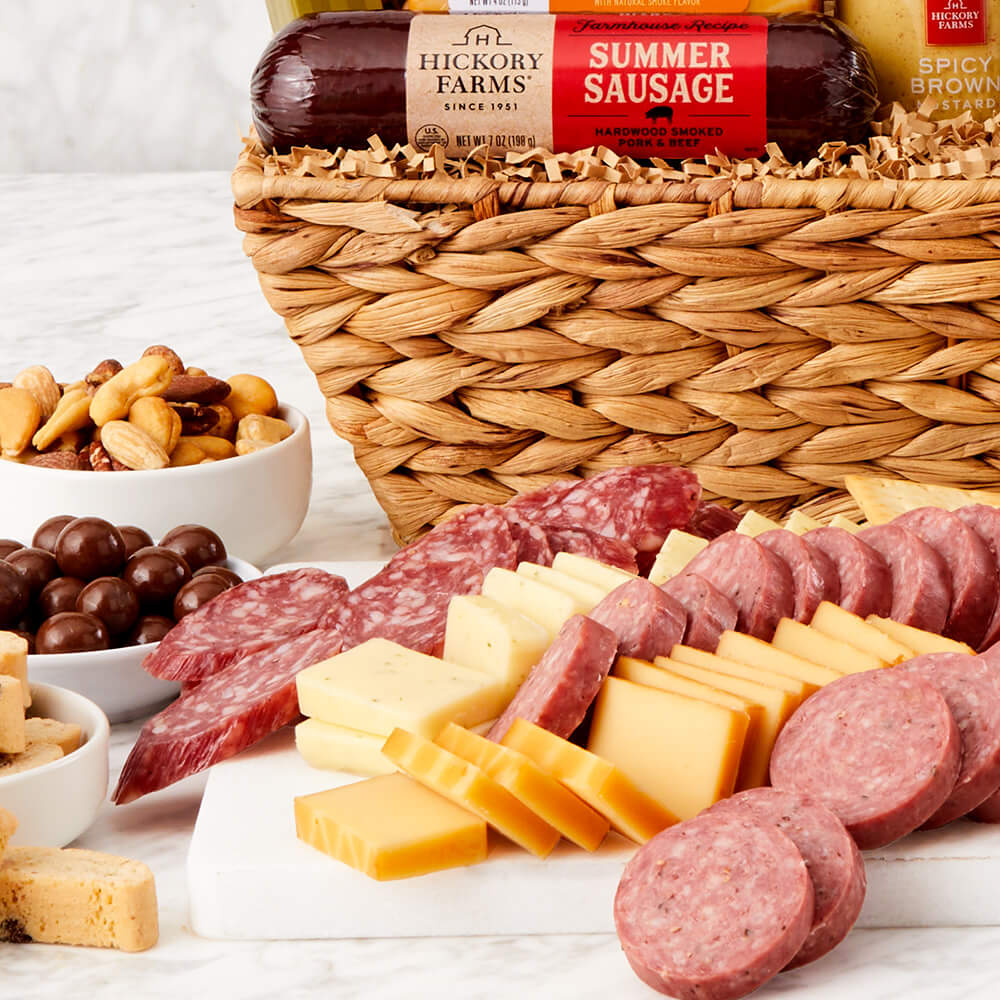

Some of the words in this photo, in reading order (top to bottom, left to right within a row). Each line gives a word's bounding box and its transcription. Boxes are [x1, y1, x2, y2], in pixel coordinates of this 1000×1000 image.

[931, 11, 979, 21] HICKORY
[573, 19, 680, 33] Farmhouse
[683, 19, 750, 33] Recipe
[938, 20, 974, 30] FARMS
[589, 41, 731, 68] SUMMER
[418, 53, 544, 71] HICKORY
[919, 56, 993, 74] SPICY
[436, 75, 526, 94] FARMS
[584, 73, 734, 103] SAUSAGE
[911, 76, 1000, 95] BROWN
[444, 103, 484, 111] SINCE
[491, 103, 518, 111] 1951
[595, 127, 667, 137] HARDWOOD
[671, 127, 723, 137] SMOKED
[456, 135, 472, 147] NET
[473, 135, 486, 147] WT
[489, 135, 494, 147] 7
[495, 135, 506, 147] OZ
[508, 135, 526, 148] (198
[618, 138, 654, 147] PORK
[658, 138, 665, 147] &
[669, 138, 701, 147] BEEF
